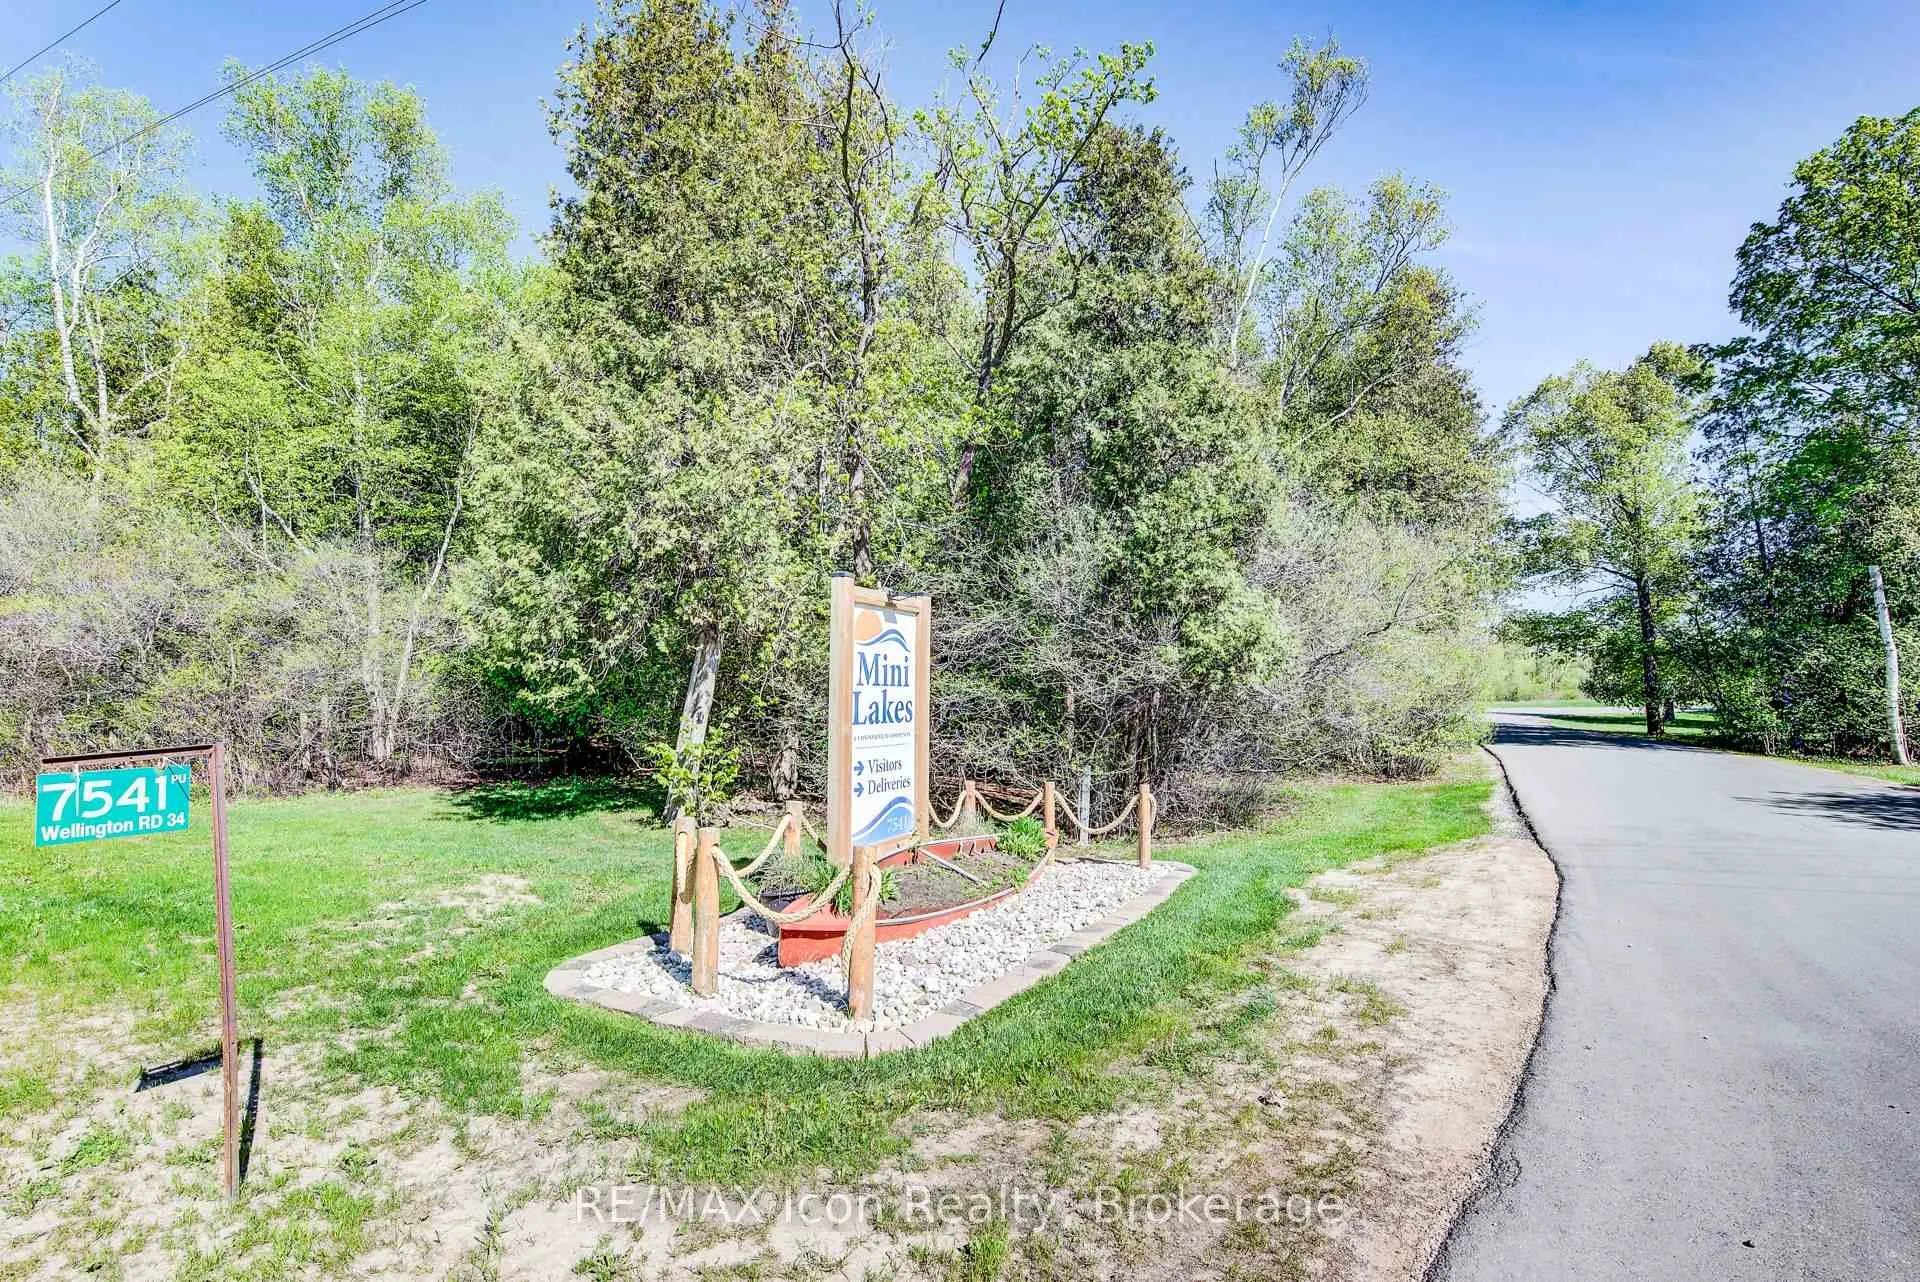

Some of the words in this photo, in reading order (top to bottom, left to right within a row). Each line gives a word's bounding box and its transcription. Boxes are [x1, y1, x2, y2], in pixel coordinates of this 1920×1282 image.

[857, 651, 910, 687] Mini
[852, 688, 913, 725] Lakes
[868, 758, 902, 774] Visitors
[42, 775, 167, 822] 7541
[171, 774, 187, 784] PU
[868, 776, 911, 795] Deliveries
[41, 819, 133, 841] Wellington
[138, 814, 163, 831] RD
[167, 812, 185, 827] 34
